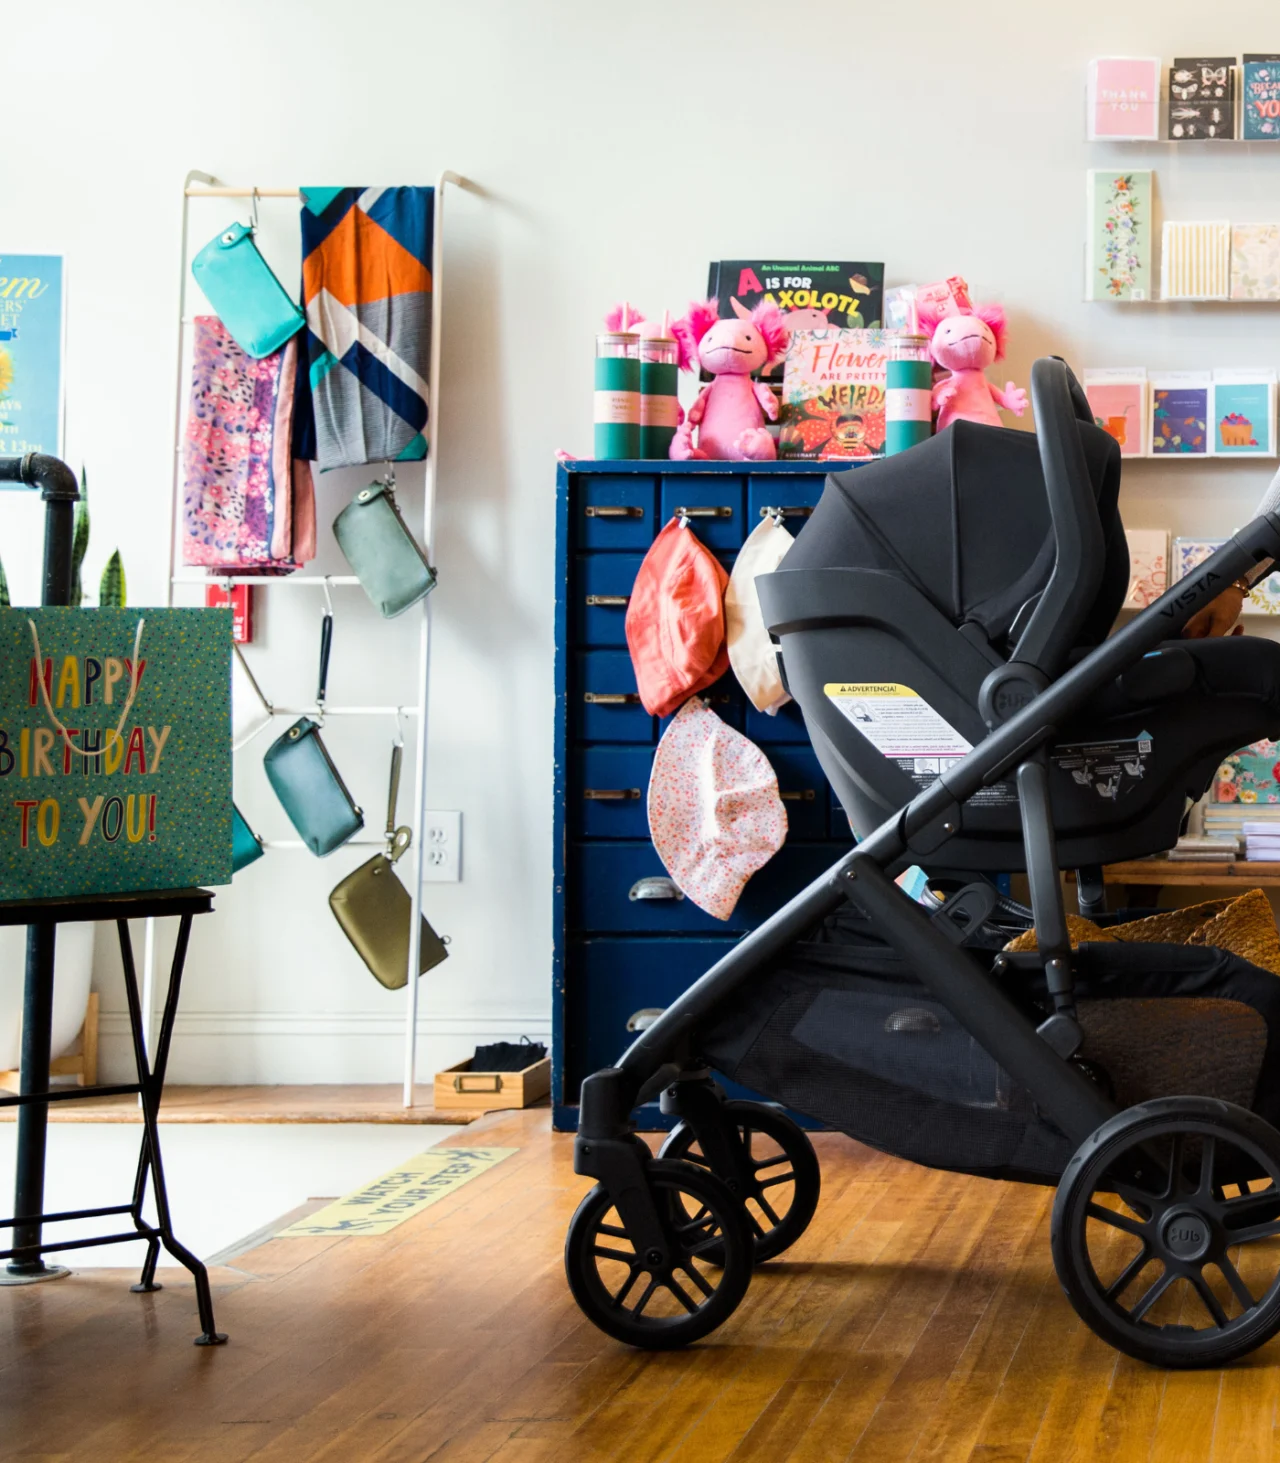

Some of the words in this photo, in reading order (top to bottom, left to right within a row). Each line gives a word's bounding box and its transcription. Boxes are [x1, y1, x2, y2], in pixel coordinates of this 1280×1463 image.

[1101, 90, 1148, 100] THANK
[1111, 102, 1140, 112] YOU
[737, 267, 764, 297] A
[765, 278, 780, 290] IS
[783, 276, 812, 289] FOR
[764, 290, 860, 318] AXOLOTL
[820, 372, 841, 381] ARE
[846, 372, 887, 381] PRETTY
[1160, 571, 1221, 619] VISTA
[29, 655, 148, 707] HAPPY
[0, 725, 172, 778] BIRTHDAY
[14, 798, 61, 848] TO
[77, 794, 157, 844] YOU!
[341, 1172, 424, 1206] WATCH
[368, 1187, 441, 1216] YOUR
[420, 1162, 477, 1186] STEP
